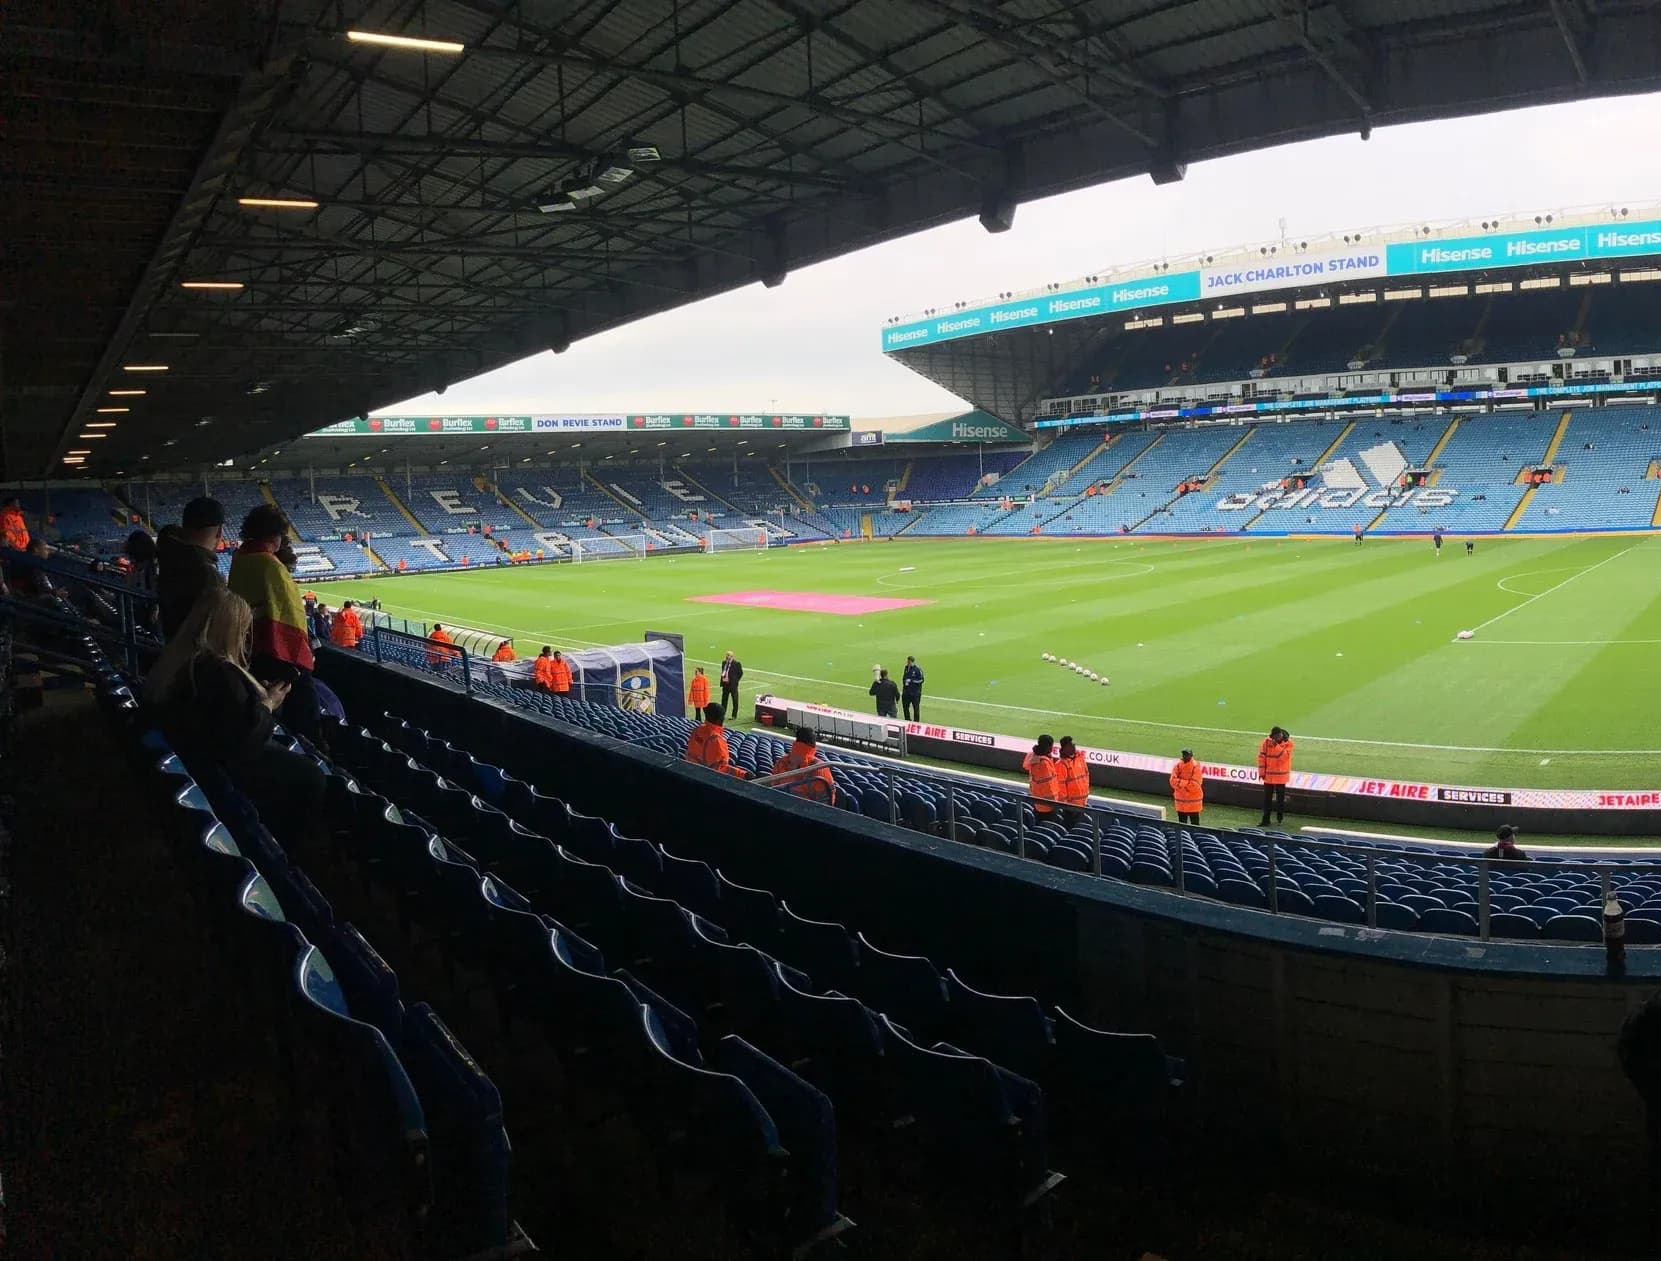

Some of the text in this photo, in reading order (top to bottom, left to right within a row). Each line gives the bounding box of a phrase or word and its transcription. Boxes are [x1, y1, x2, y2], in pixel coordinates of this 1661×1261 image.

[1421, 247, 1493, 264] Hisense
[1507, 238, 1581, 256] Hisense
[1207, 255, 1379, 288] JACK CHARLTON STAND
[1113, 284, 1168, 304] Hisense
[1049, 295, 1101, 314] Hisense
[990, 305, 1038, 324] Hisense
[937, 315, 980, 334] Hisense
[887, 326, 928, 344] Hisense
[383, 418, 415, 428] Burflex
[442, 418, 472, 427] Burflex
[498, 418, 524, 426] Burflex
[537, 418, 622, 428] DON REVIE STAND
[952, 423, 1008, 438] Hisense
[906, 723, 946, 738] JET AIRE
[955, 732, 993, 745] SERVICES
[1359, 780, 1429, 799] JET AIRE
[1444, 789, 1504, 803] SERVICES
